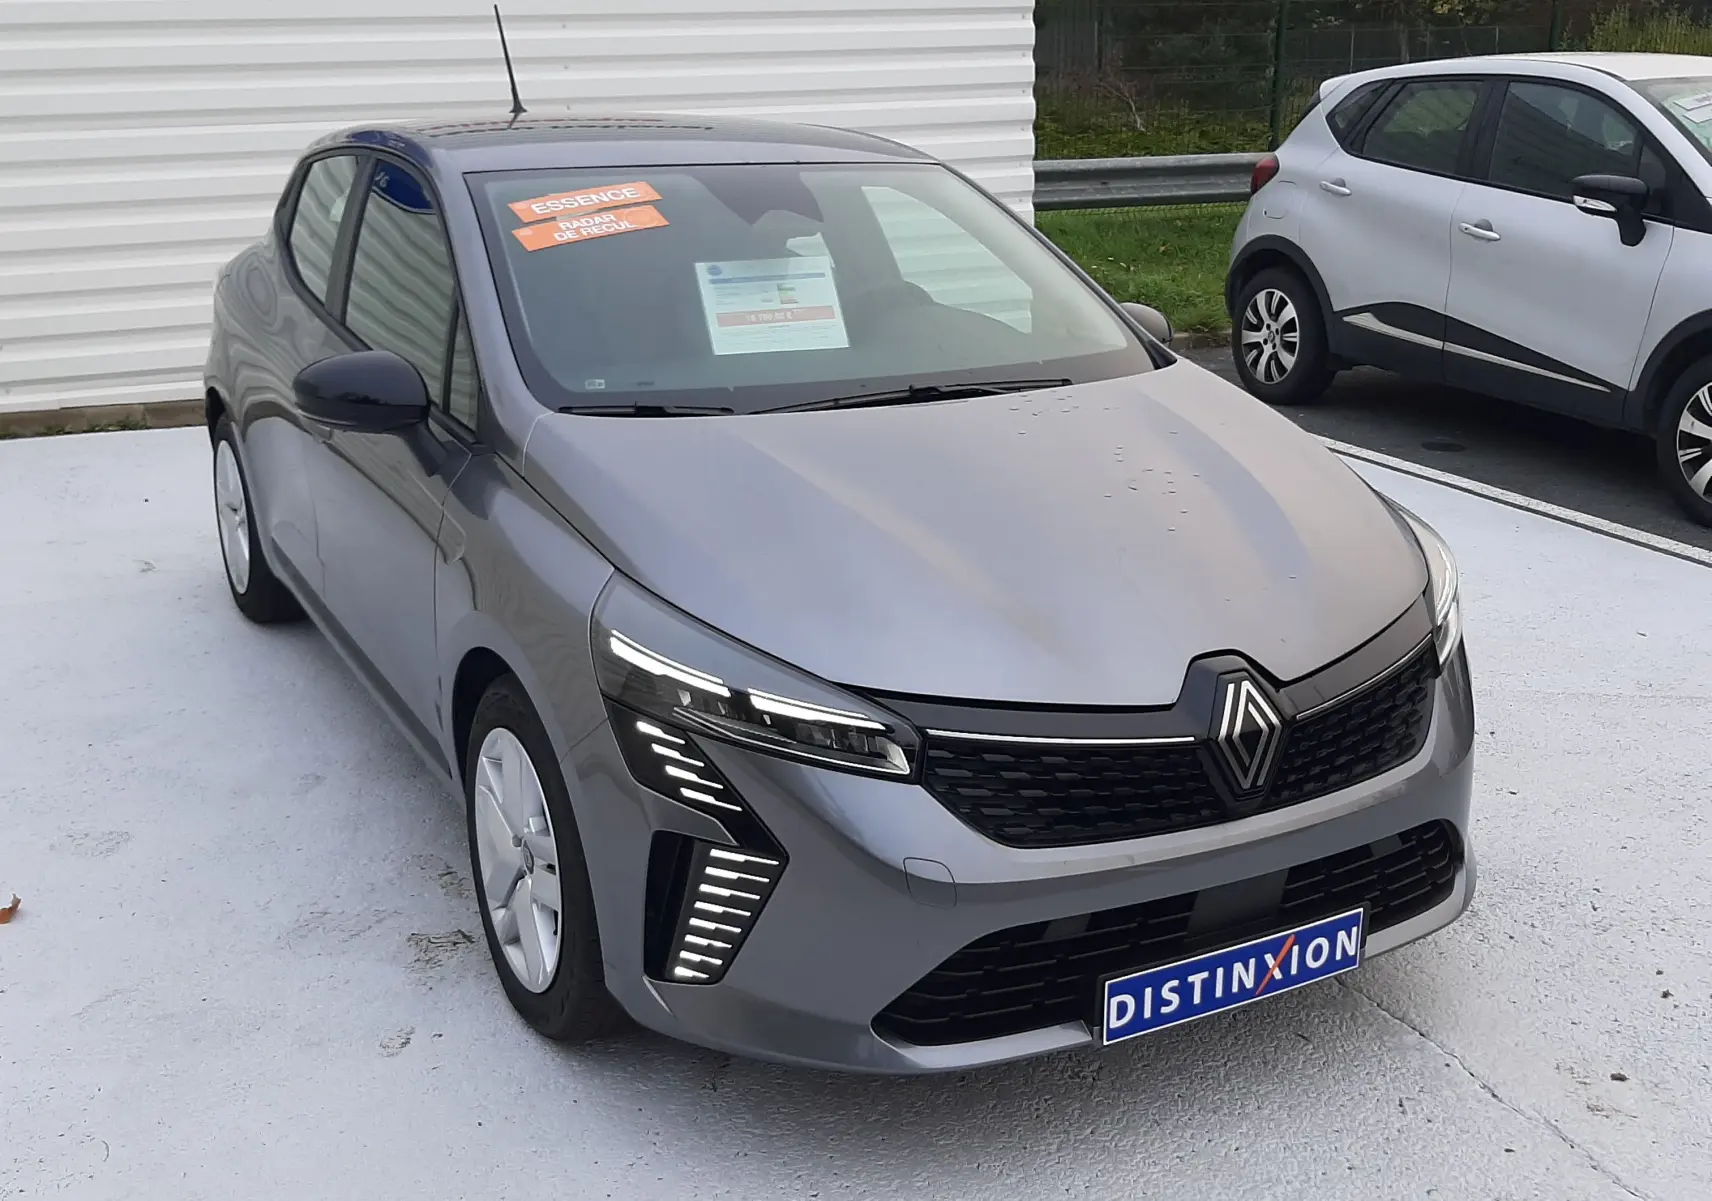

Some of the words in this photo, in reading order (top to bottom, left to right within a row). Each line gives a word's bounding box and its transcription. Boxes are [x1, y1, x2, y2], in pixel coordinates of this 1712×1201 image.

[530, 187, 641, 215] ESSENCE
[553, 230, 579, 242] DE
[581, 221, 636, 237] RECUL
[559, 214, 617, 231] RADAR
[1109, 926, 1358, 1029] DISTINXION
